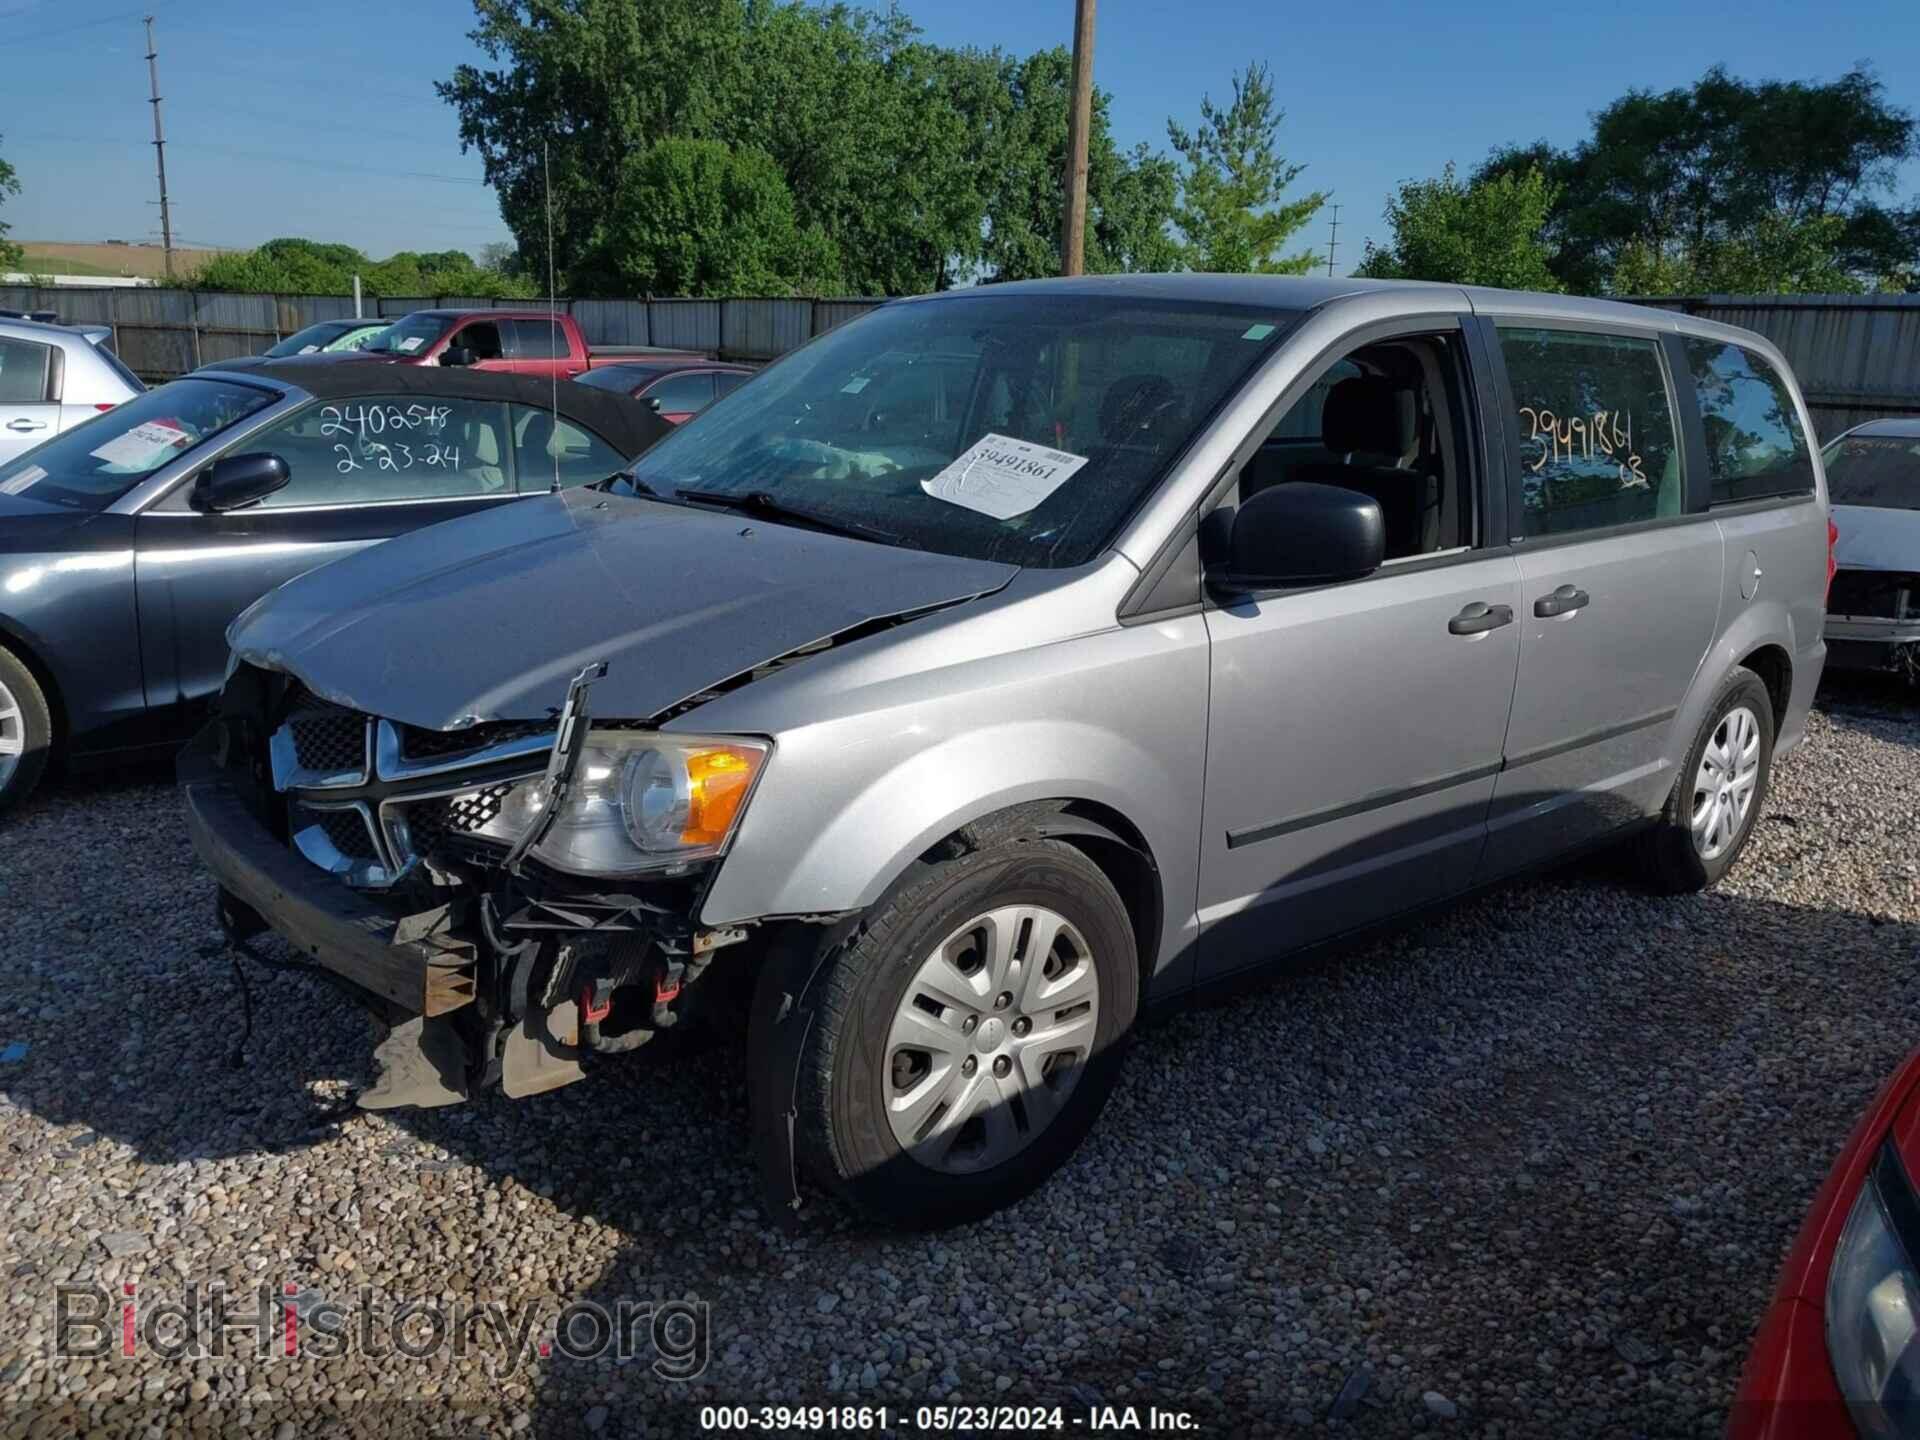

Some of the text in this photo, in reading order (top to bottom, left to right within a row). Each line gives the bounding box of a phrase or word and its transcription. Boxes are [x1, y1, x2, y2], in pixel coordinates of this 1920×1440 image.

[1519, 407, 1632, 472] 39491861
[333, 443, 459, 473] 2-23-24
[976, 448, 1058, 480] 39491861
